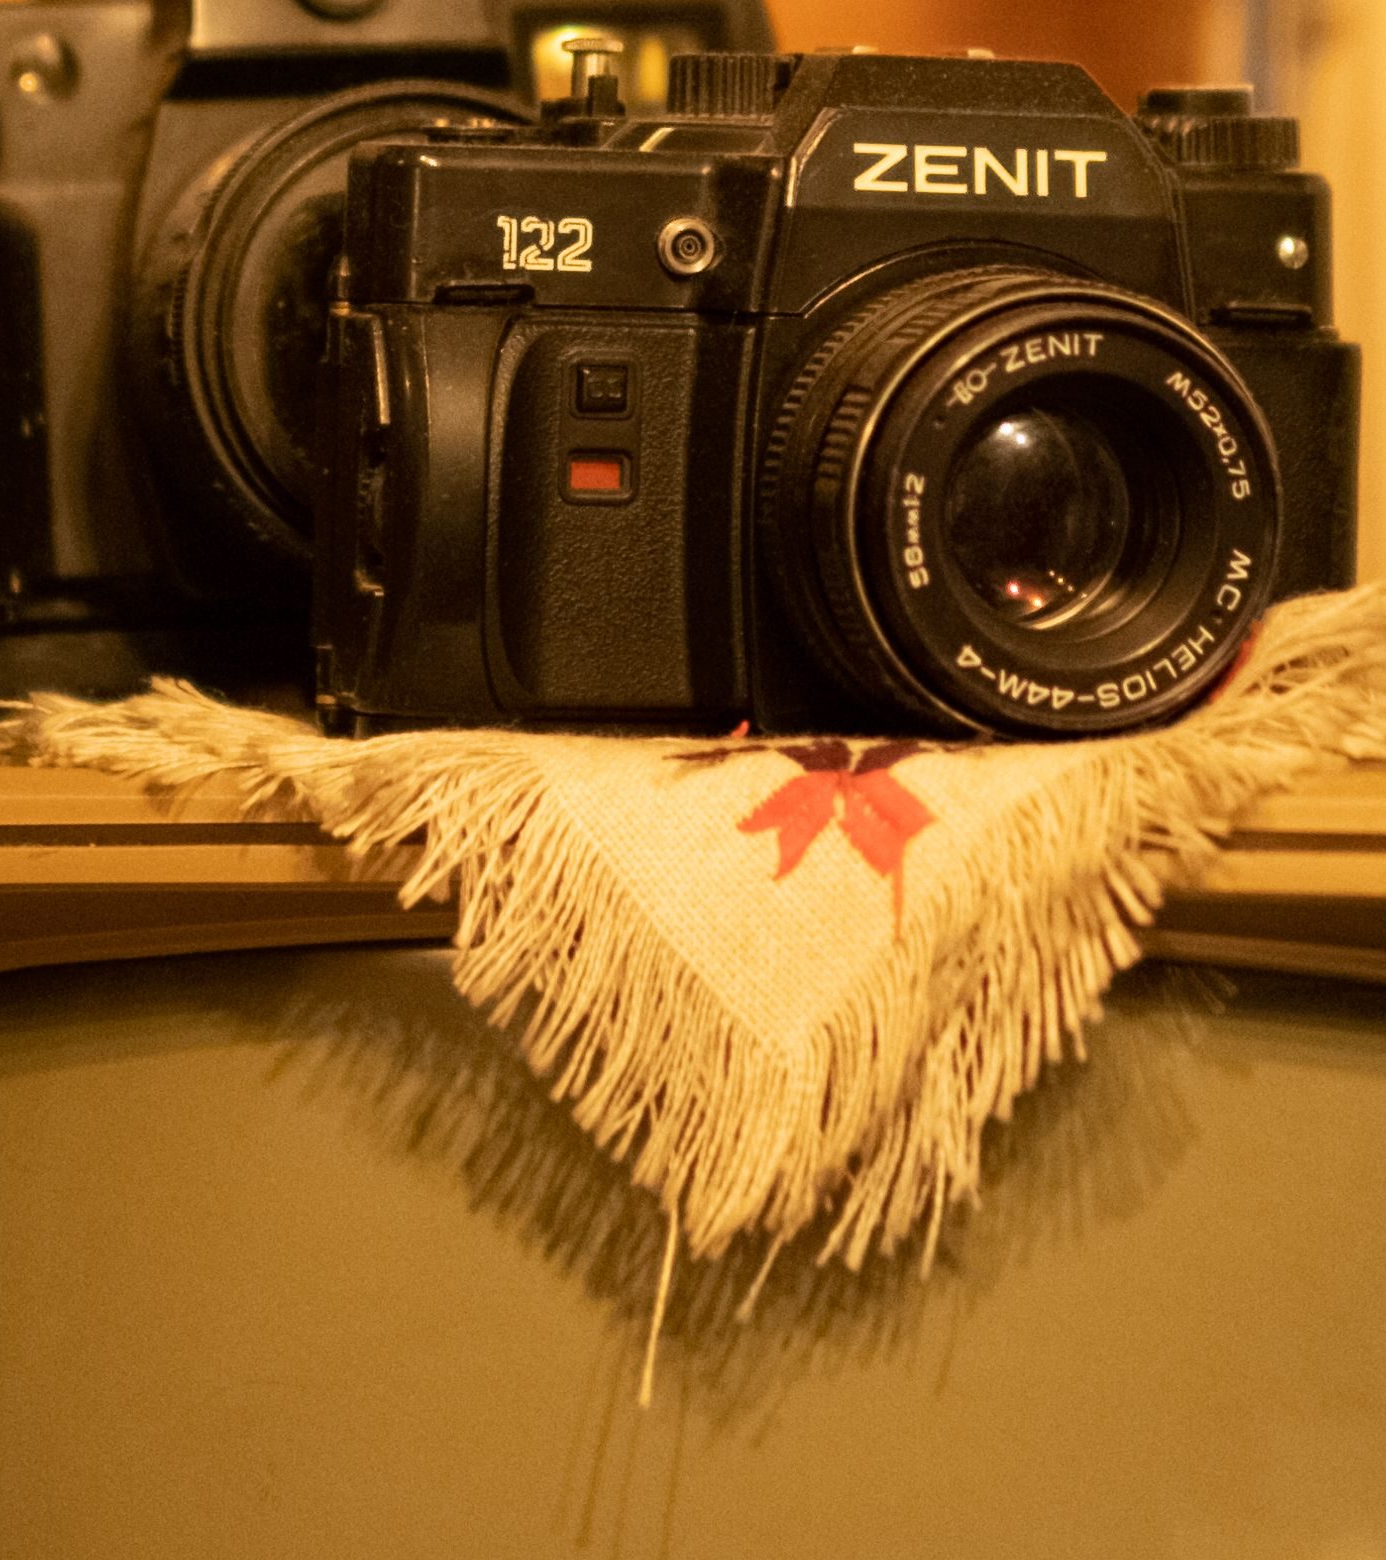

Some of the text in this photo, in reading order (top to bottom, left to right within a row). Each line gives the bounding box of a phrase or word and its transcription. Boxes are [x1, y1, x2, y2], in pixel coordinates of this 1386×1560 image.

[852, 141, 1109, 199] ZENIT
[496, 214, 594, 273] 122
[1000, 332, 1104, 373] ZENIT
[1216, 549, 1253, 612] MC
